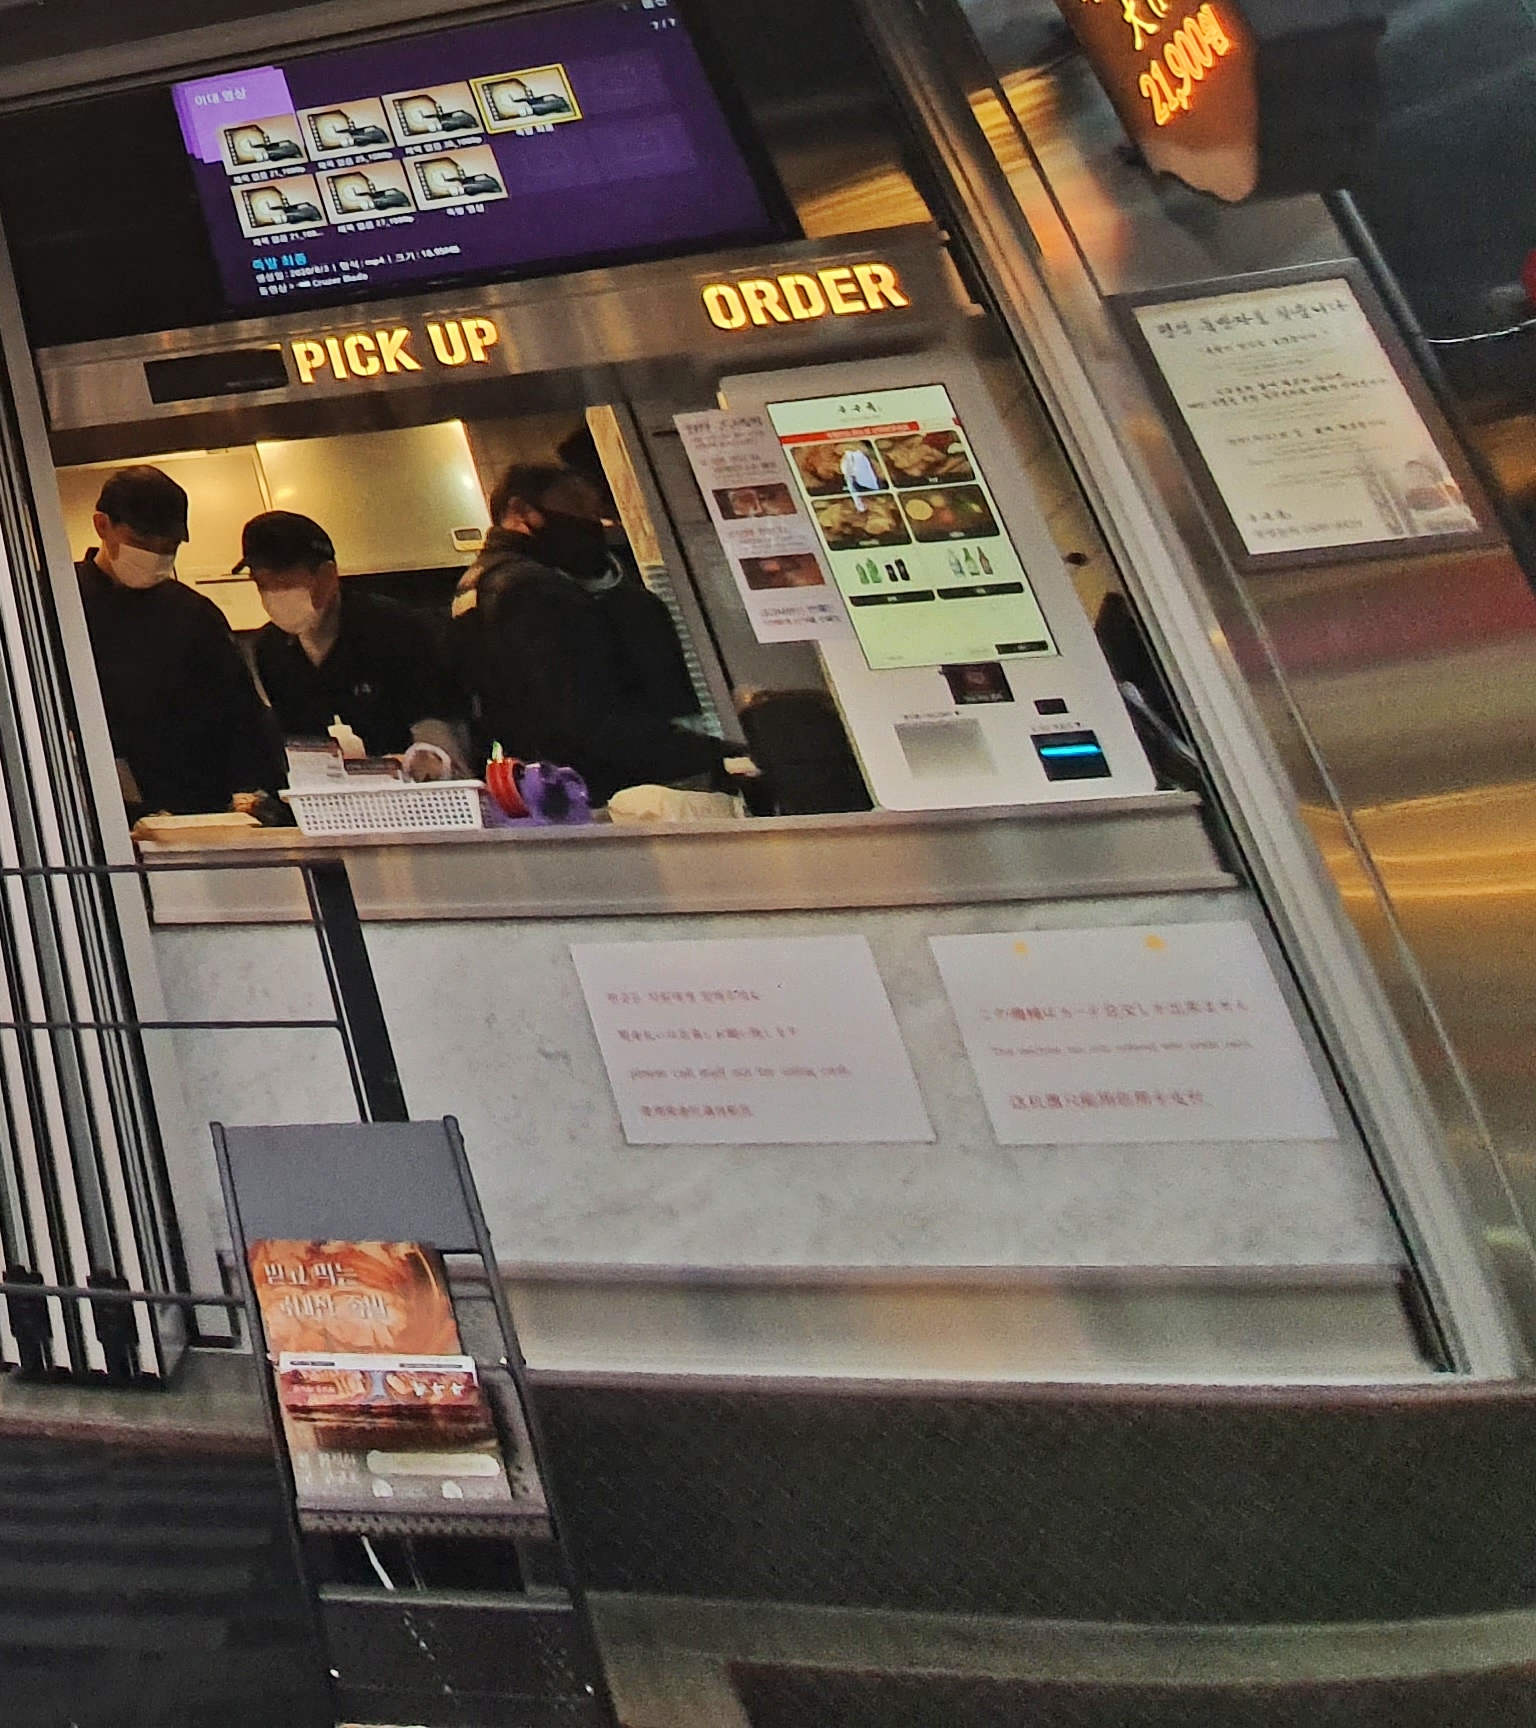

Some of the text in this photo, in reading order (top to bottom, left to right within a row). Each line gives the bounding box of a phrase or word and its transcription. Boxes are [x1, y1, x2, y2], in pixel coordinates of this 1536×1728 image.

[1139, 3, 1230, 126] 21,900원
[701, 262, 910, 332] ORDER
[291, 317, 500, 385] PICK UP
